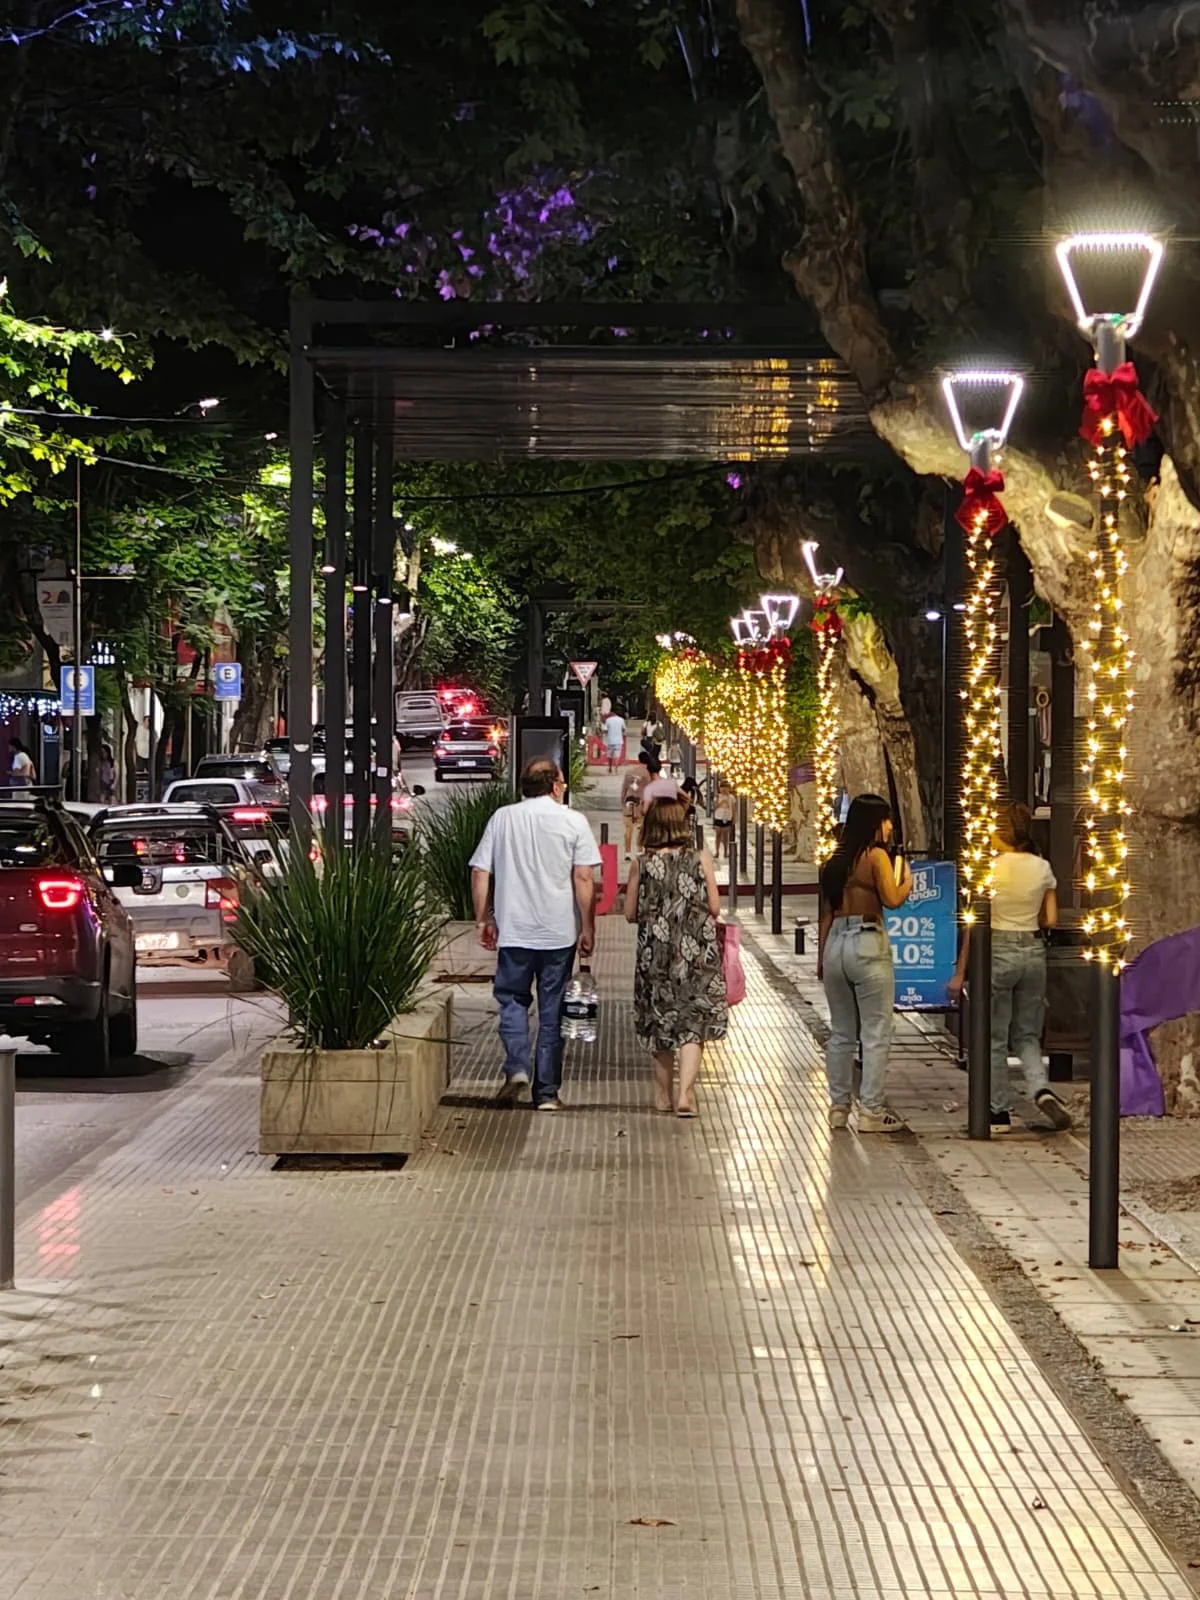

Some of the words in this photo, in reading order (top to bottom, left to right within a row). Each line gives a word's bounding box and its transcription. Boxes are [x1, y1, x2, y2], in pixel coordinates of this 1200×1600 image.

[224, 668, 233, 680] E
[887, 915, 935, 937] 20%
[890, 943, 935, 964] 10%
